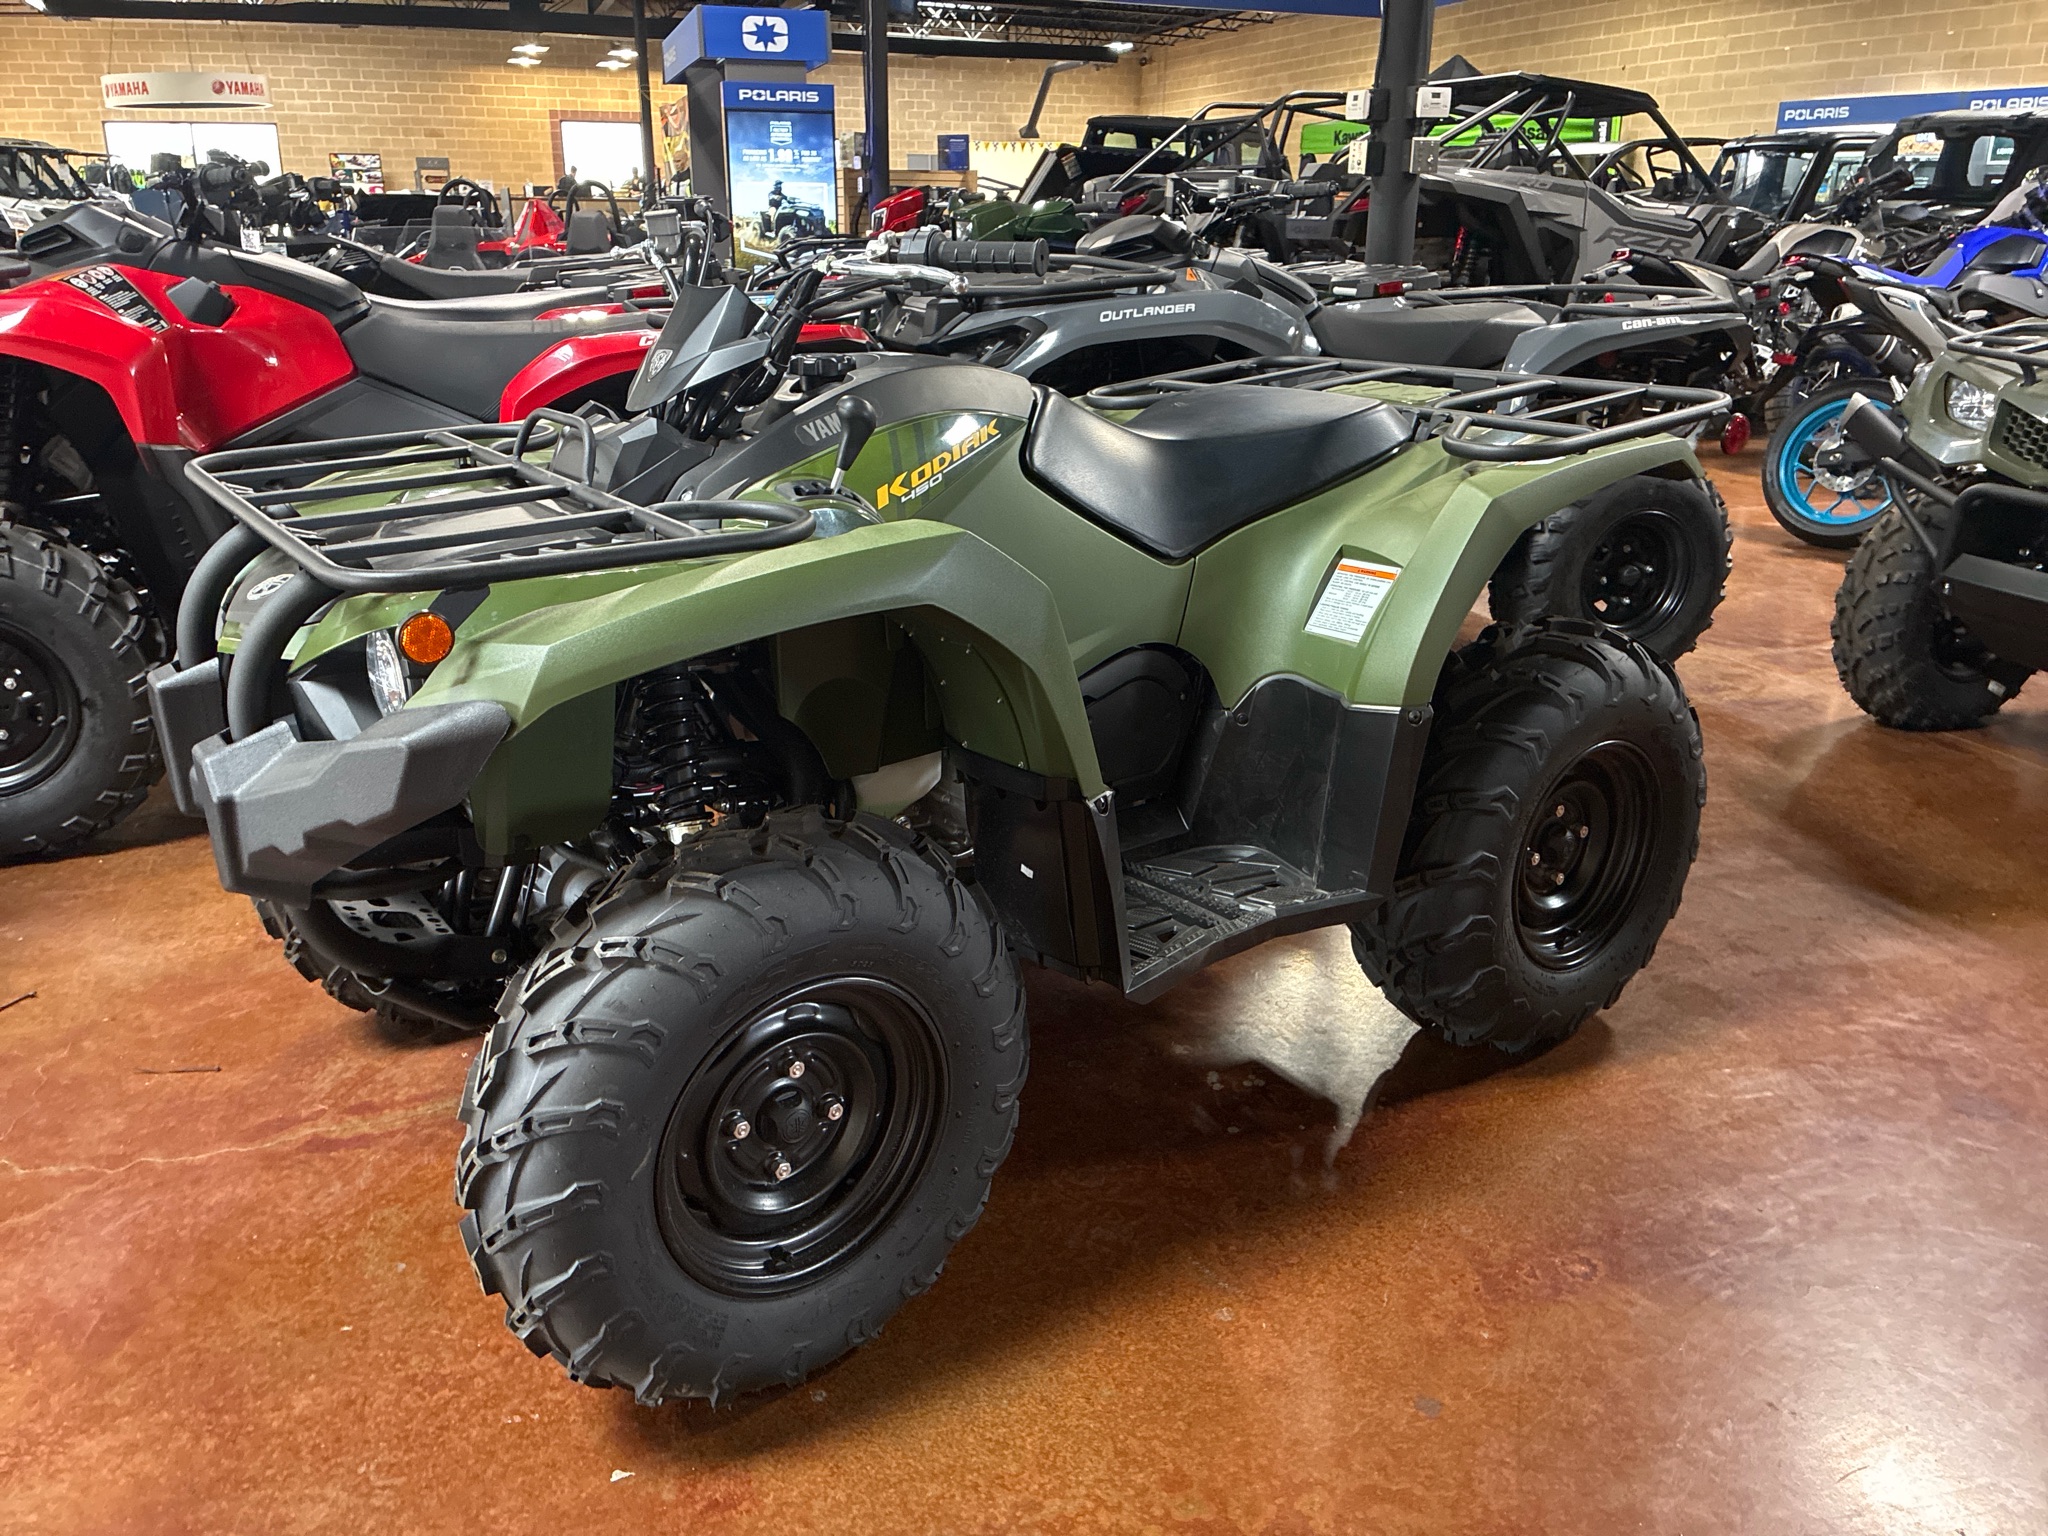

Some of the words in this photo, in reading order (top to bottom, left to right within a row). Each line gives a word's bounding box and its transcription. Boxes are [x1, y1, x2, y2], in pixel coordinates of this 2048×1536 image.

[110, 81, 150, 96] YAMAHA
[224, 81, 265, 96] YAMAHA
[738, 89, 819, 102] POLARIS
[1784, 106, 1850, 122] POLARIS
[1593, 227, 1693, 257] RZR
[1099, 303, 1196, 323] OUTLANDER
[1621, 316, 1681, 331] can-am
[802, 412, 842, 442] YAM
[876, 418, 1001, 510] KODIAK
[900, 472, 943, 504] 450
